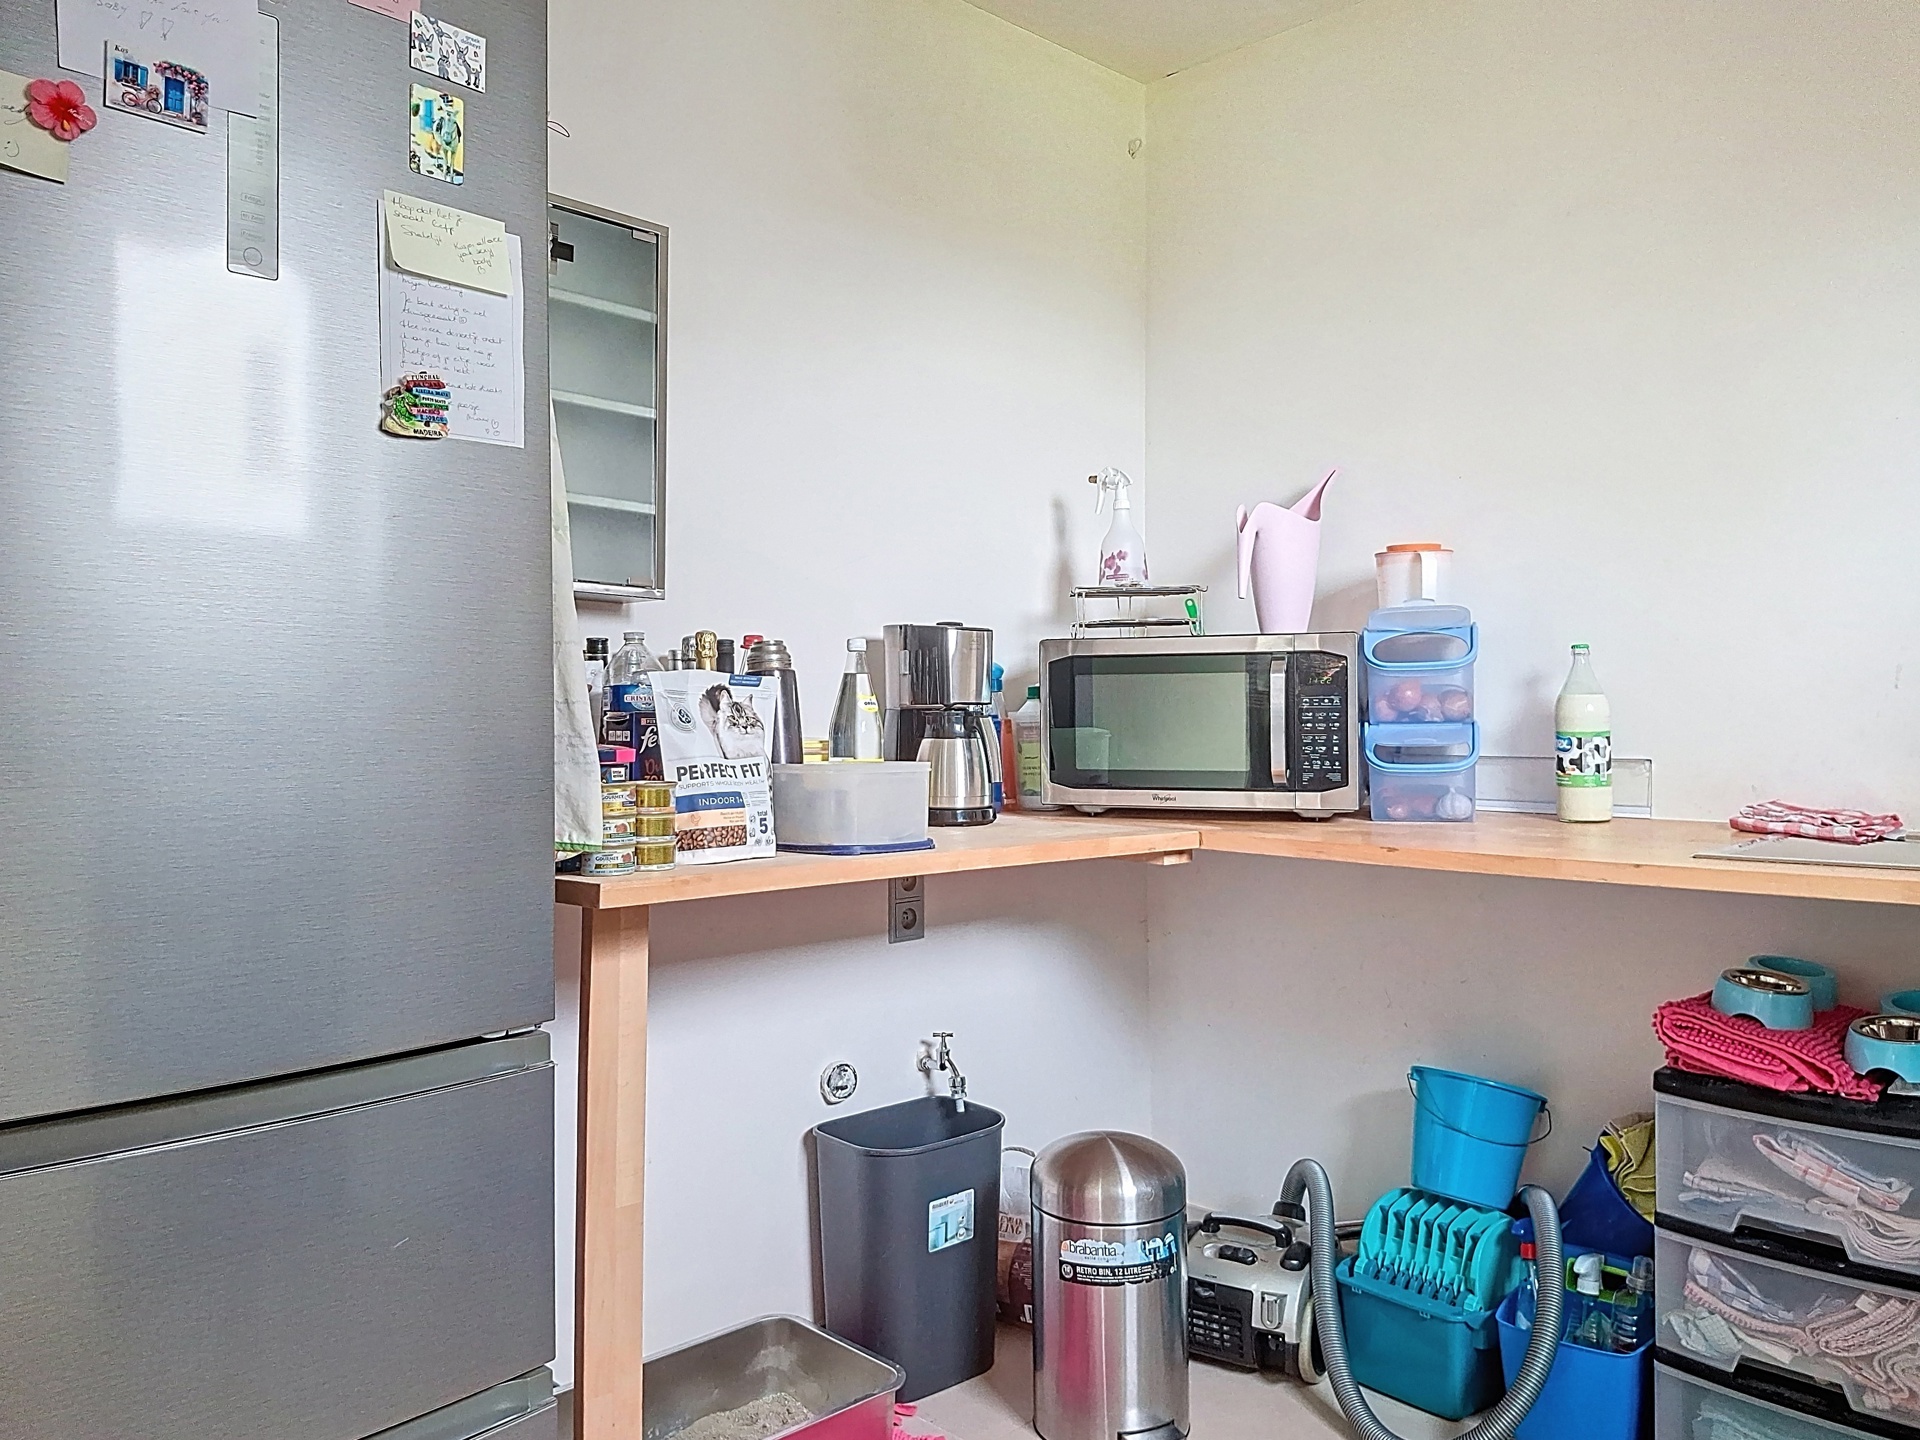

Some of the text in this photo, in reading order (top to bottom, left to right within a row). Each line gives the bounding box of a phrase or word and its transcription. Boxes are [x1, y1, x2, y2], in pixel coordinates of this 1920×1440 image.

[114, 45, 129, 54] Kos
[413, 428, 444, 437] MADEIRA
[676, 762, 761, 782] PERFECT FIT
[679, 781, 715, 790] SUPPORTS
[698, 796, 735, 806] INDOOR
[759, 817, 768, 834] 5
[1069, 1240, 1117, 1257] brabantia
[1076, 1265, 1098, 1275] RETRO
[1114, 1268, 1123, 1276] 12
[1124, 1266, 1142, 1275] LITRE
